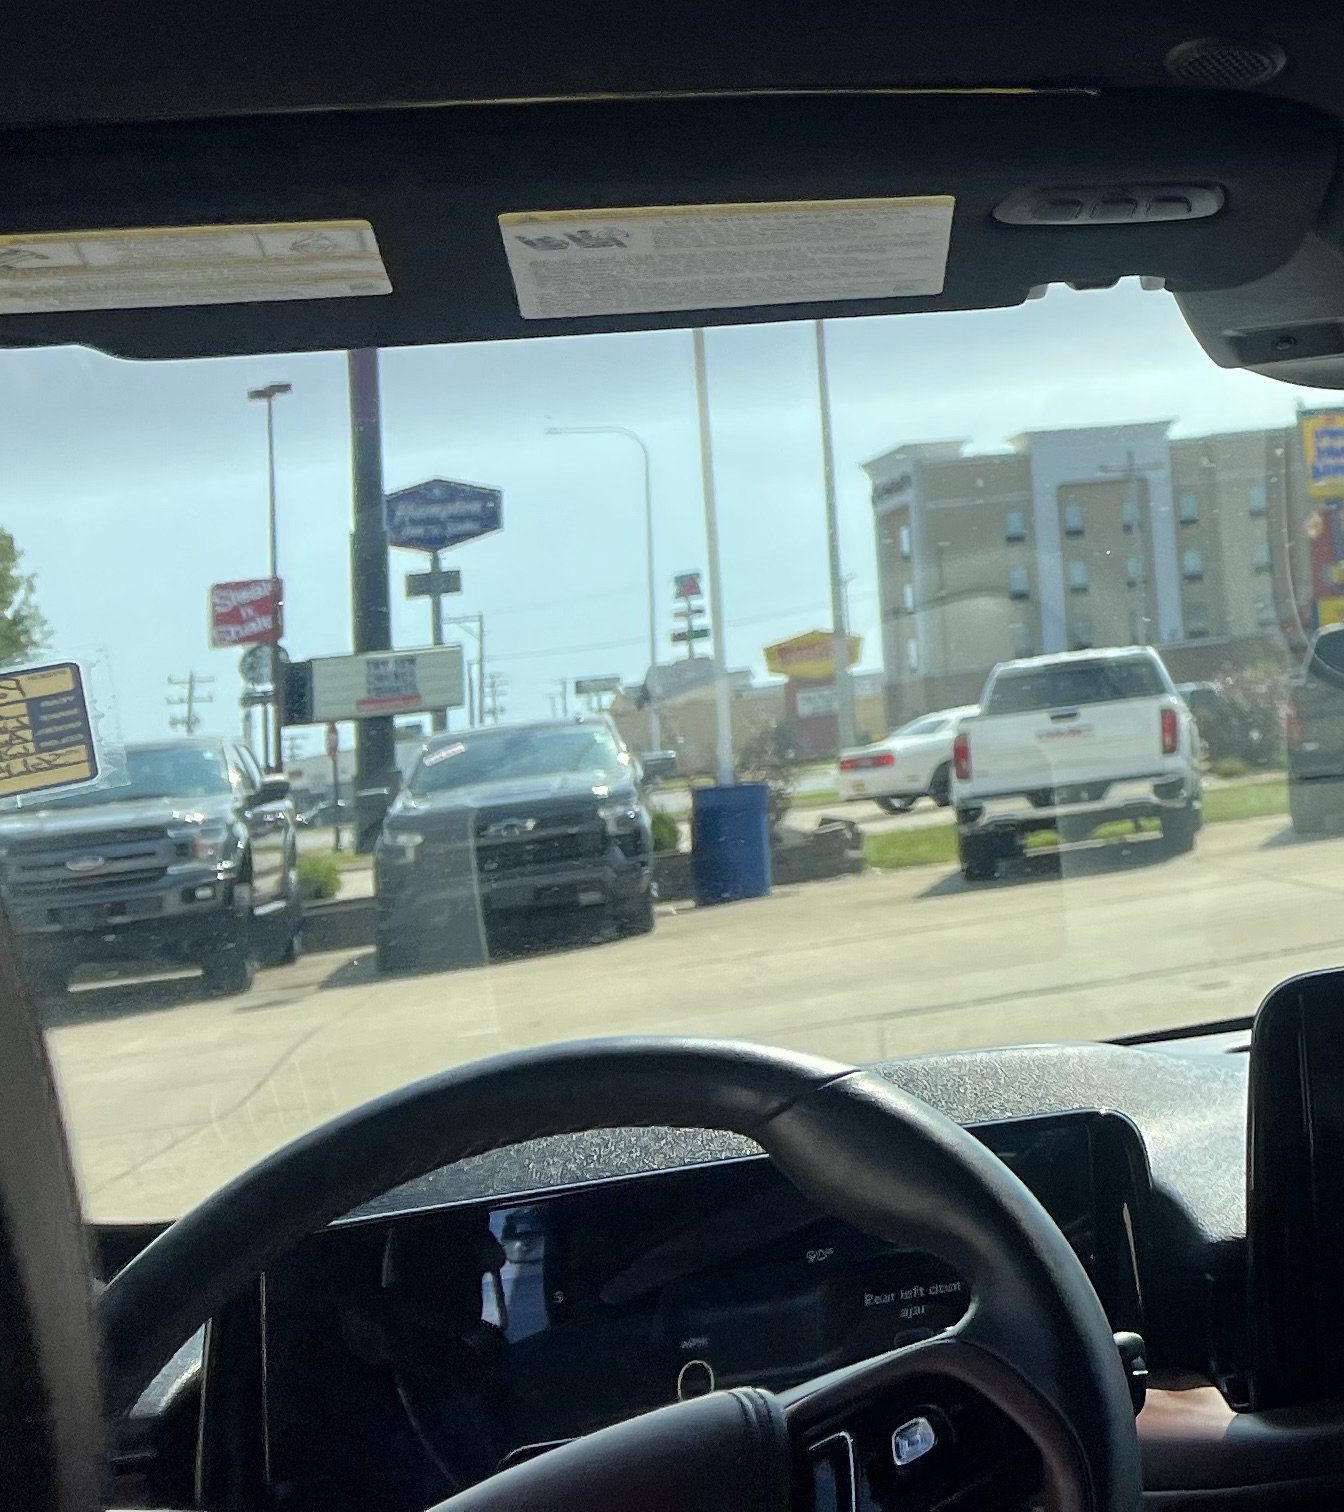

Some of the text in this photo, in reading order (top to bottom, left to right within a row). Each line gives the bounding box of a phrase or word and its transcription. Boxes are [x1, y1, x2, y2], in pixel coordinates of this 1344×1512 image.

[864, 1292, 895, 1307] Rear
[900, 1285, 925, 1301] left
[900, 1304, 925, 1319] ajar
